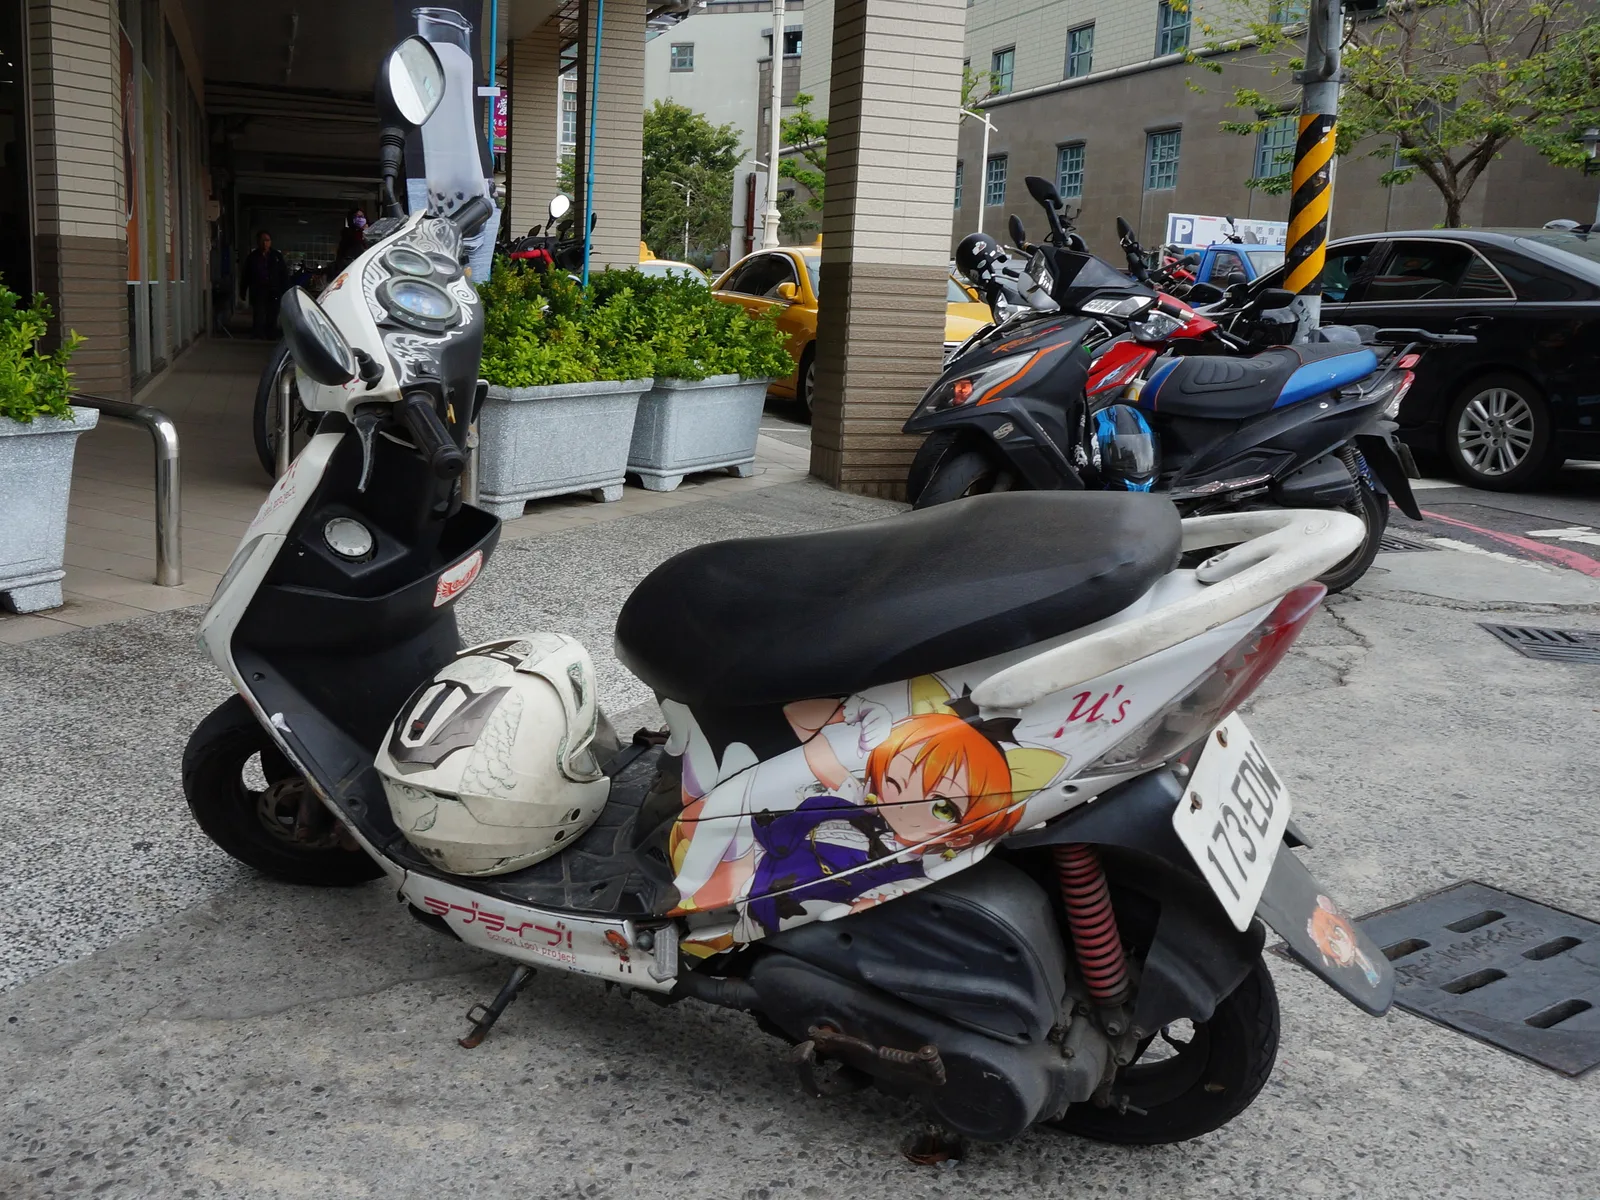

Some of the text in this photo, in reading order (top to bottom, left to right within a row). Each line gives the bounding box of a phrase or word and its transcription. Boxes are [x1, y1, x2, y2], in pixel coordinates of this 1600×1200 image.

[1175, 219, 1193, 242] P
[487, 931, 576, 963] School idol project
